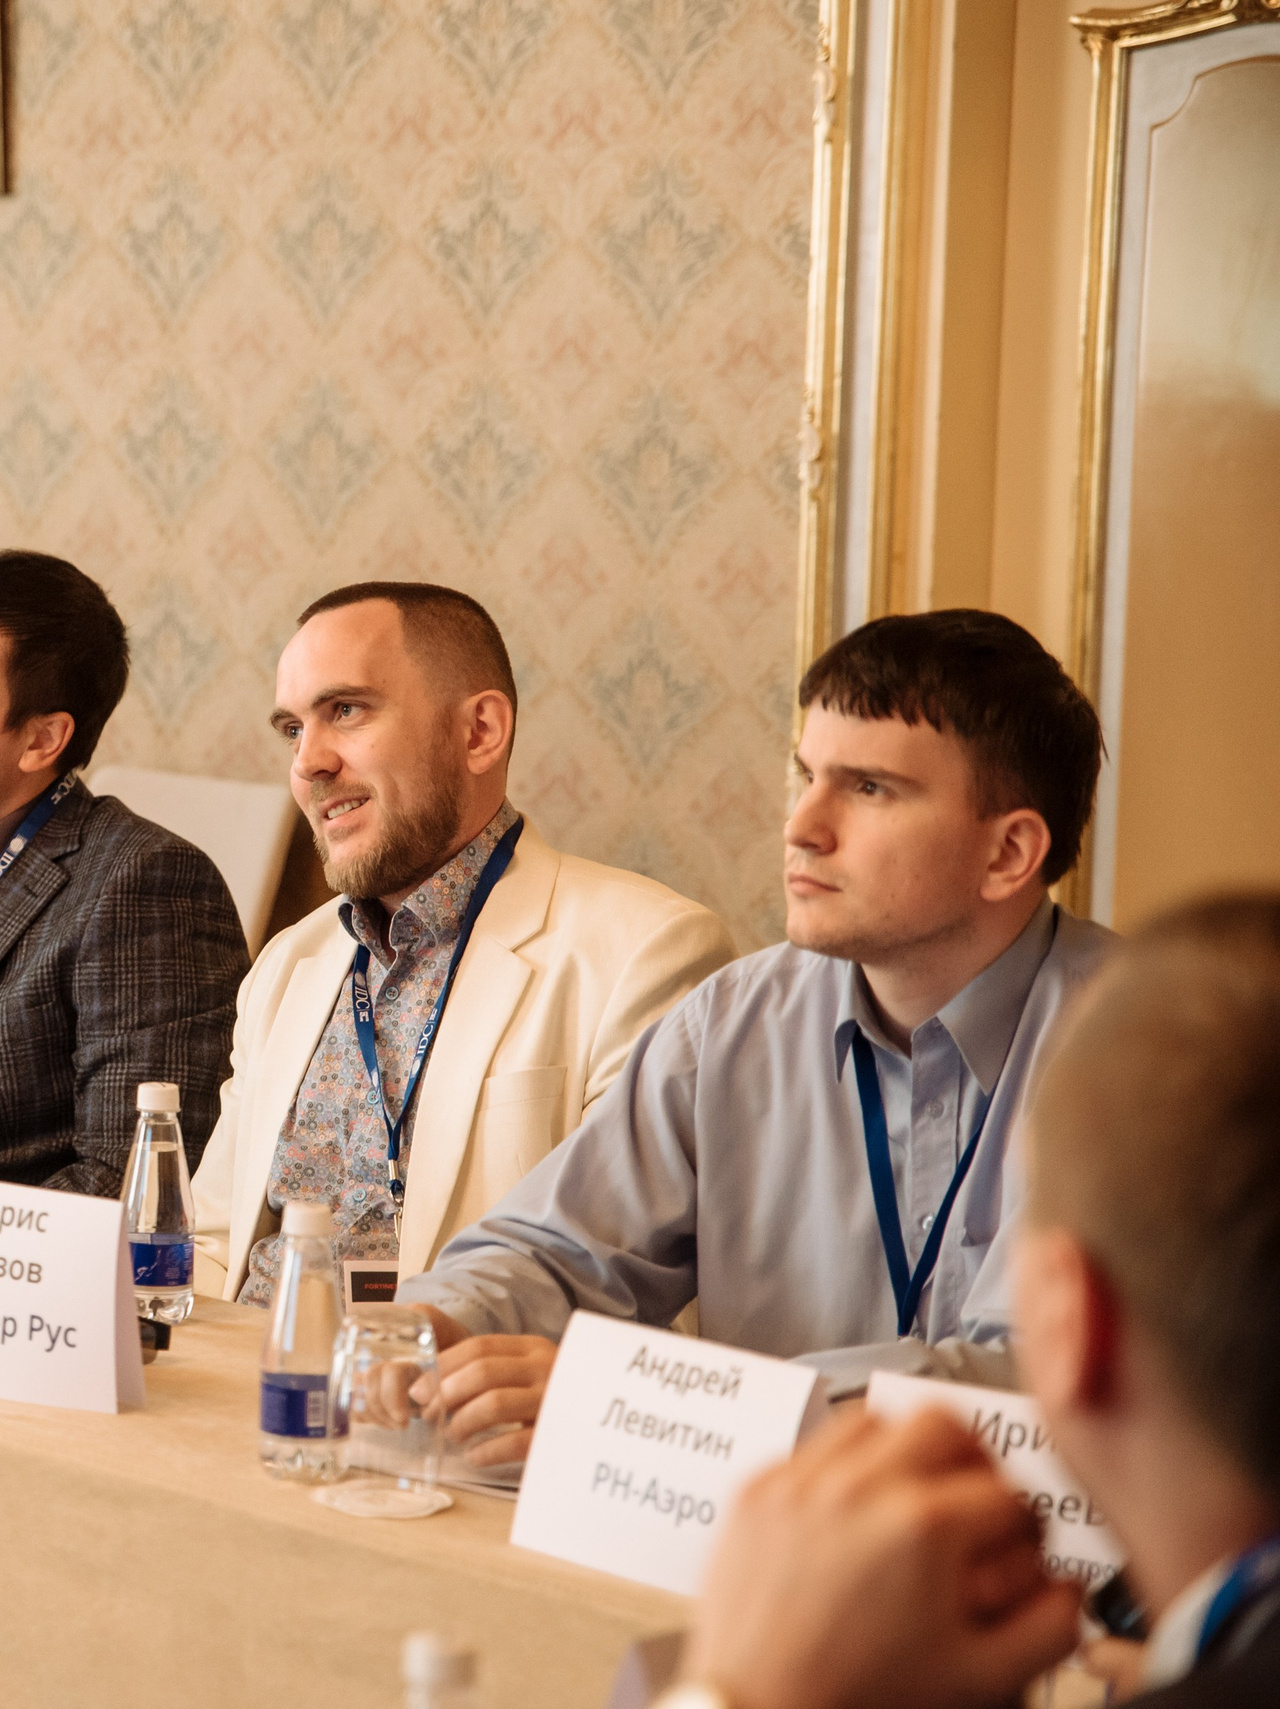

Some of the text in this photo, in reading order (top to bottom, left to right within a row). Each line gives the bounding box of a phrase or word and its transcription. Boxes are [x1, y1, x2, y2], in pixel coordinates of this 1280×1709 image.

[354, 986, 370, 1009] IDC
[417, 1024, 433, 1054] IDC
[28, 1315, 78, 1353] Рус
[627, 1345, 745, 1400] Андрей
[599, 1398, 735, 1462] Левитин
[592, 1461, 716, 1527] РН-Аэро
